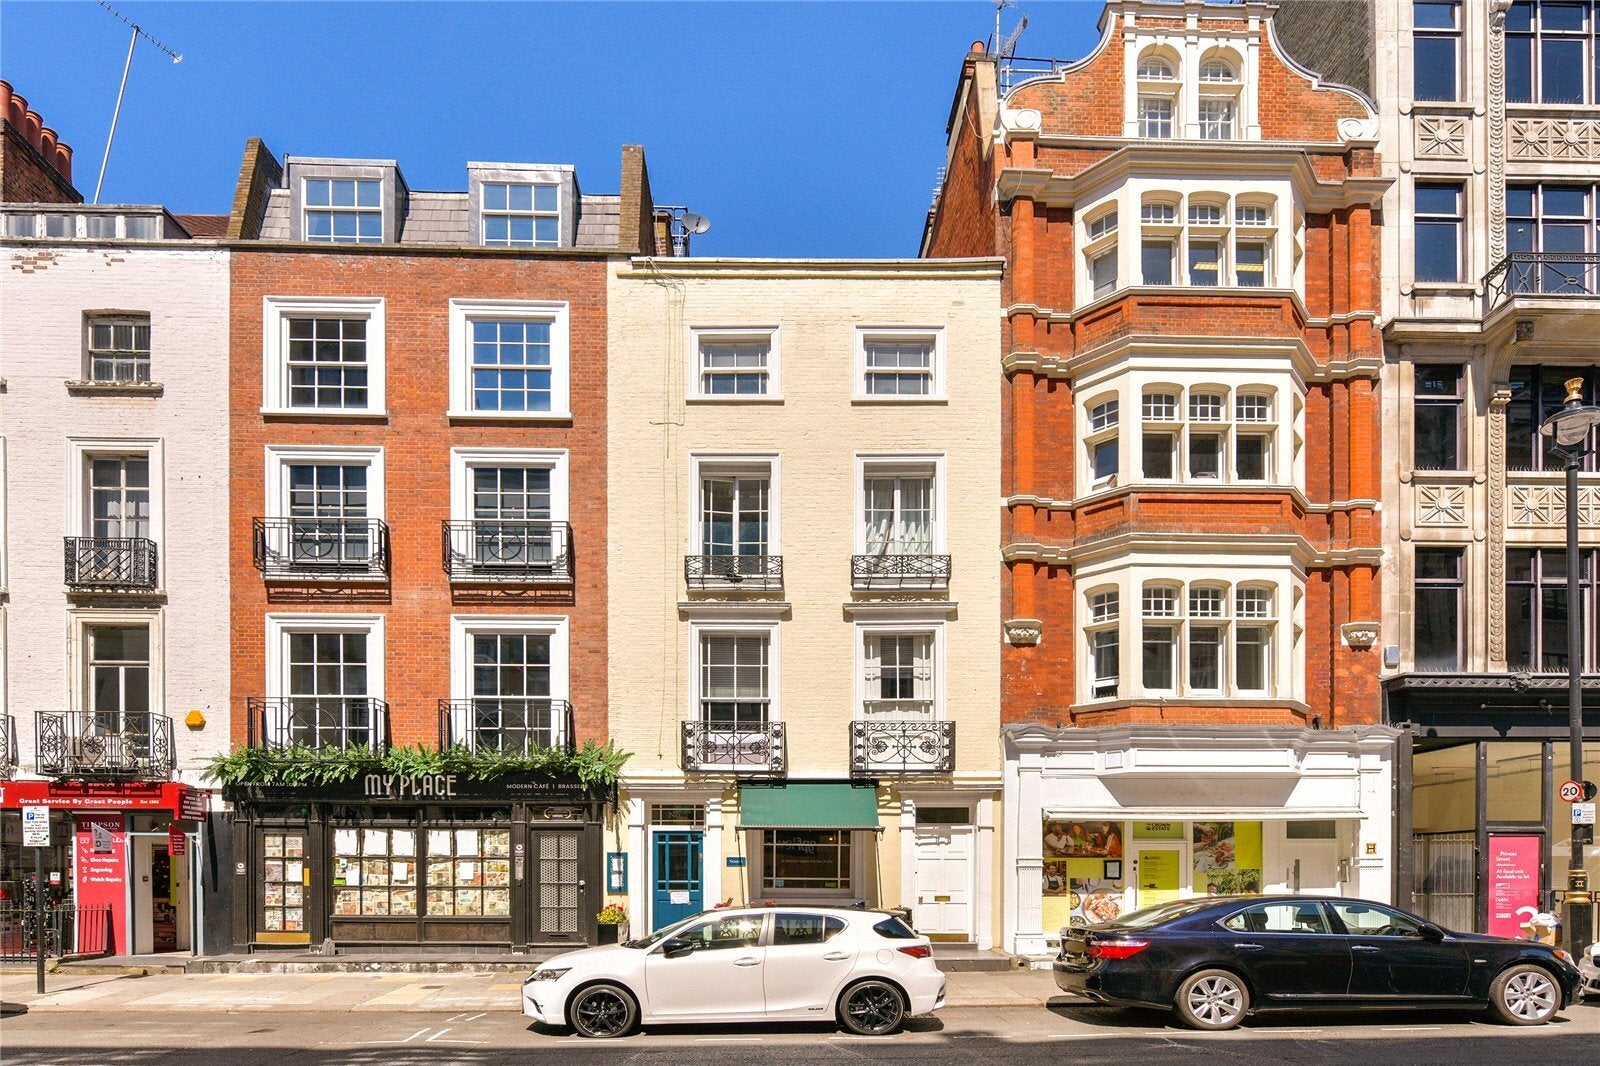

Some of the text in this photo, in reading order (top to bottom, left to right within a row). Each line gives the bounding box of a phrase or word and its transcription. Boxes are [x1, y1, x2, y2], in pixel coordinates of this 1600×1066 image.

[364, 774, 457, 796] MY PLACE
[1563, 786, 1578, 797] 20
[107, 798, 134, 806] People
